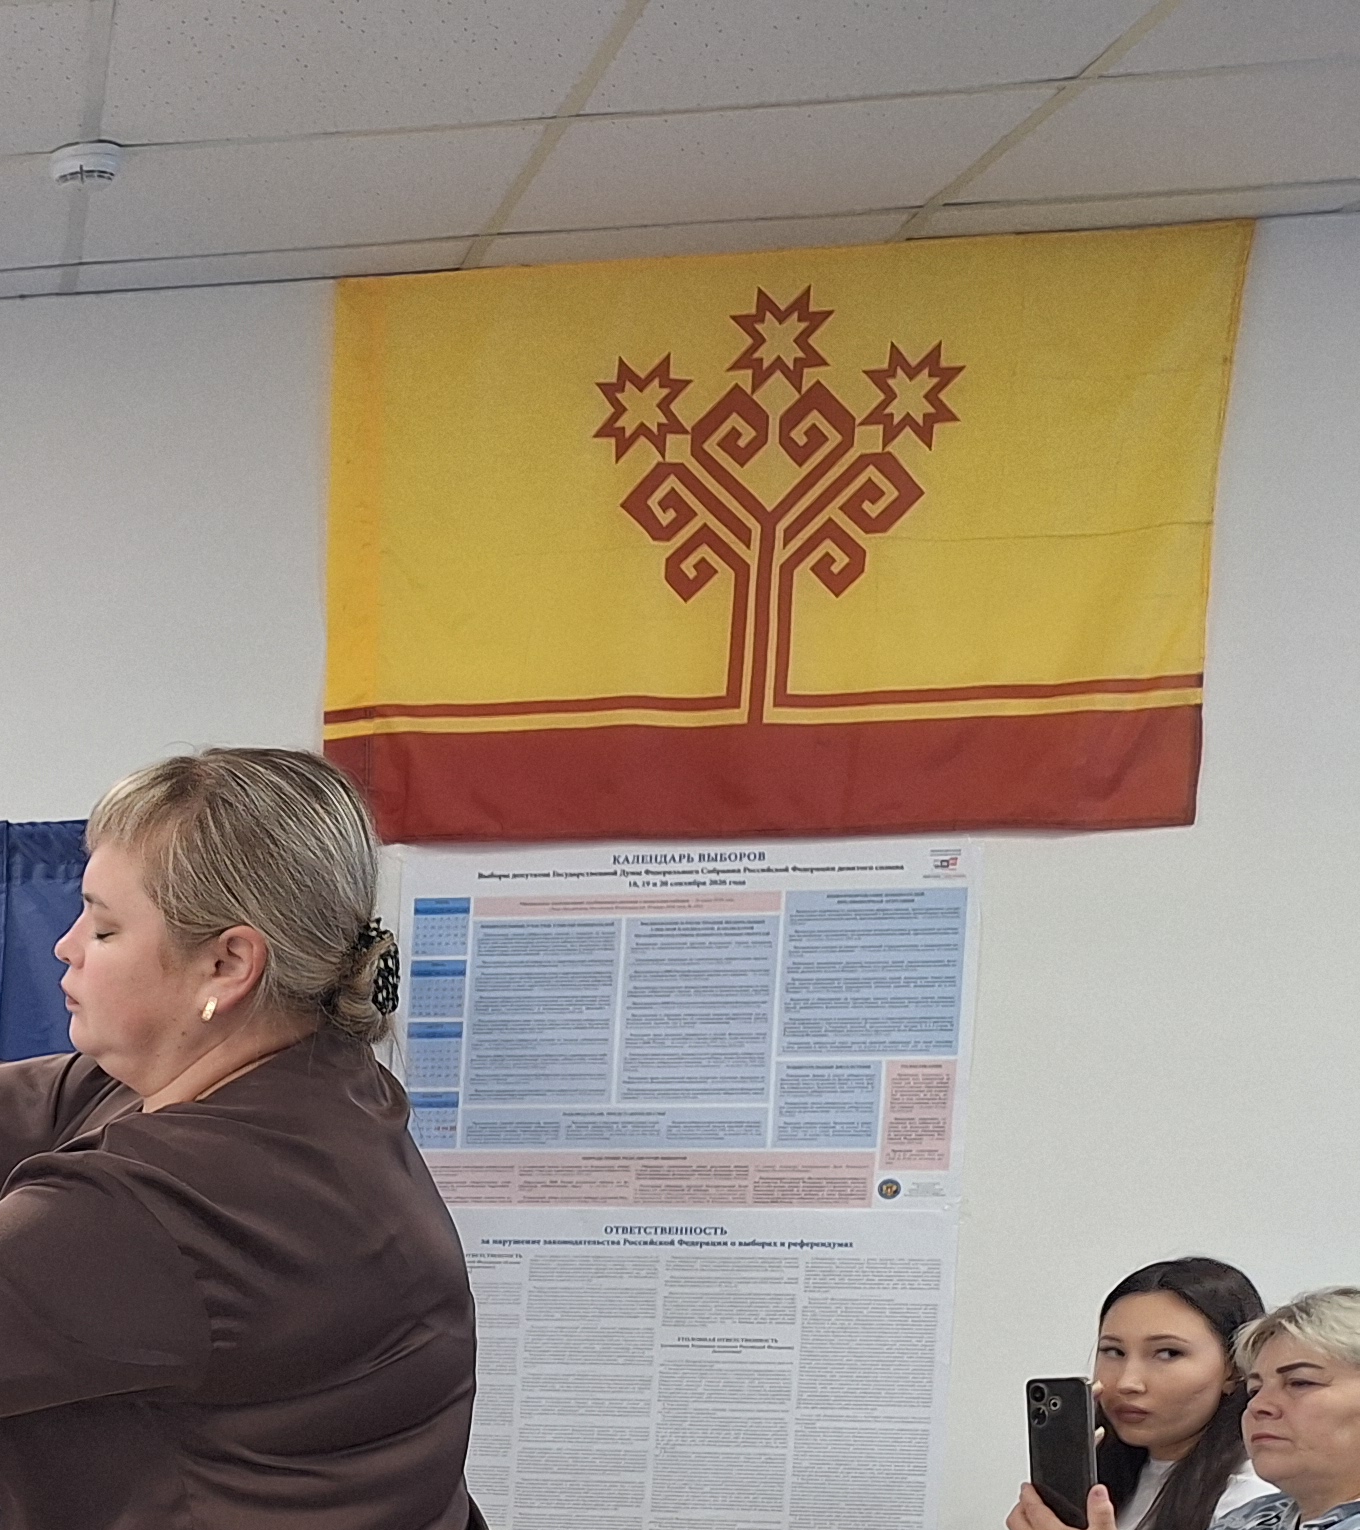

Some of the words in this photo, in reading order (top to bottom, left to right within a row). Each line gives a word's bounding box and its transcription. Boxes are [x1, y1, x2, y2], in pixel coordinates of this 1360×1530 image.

[613, 853, 694, 865] КАЛЕНДАРЬ
[698, 851, 766, 863] ВЫБОРОВ
[603, 1225, 728, 1236] ОТВЕТСТВЕННОСТЬ
